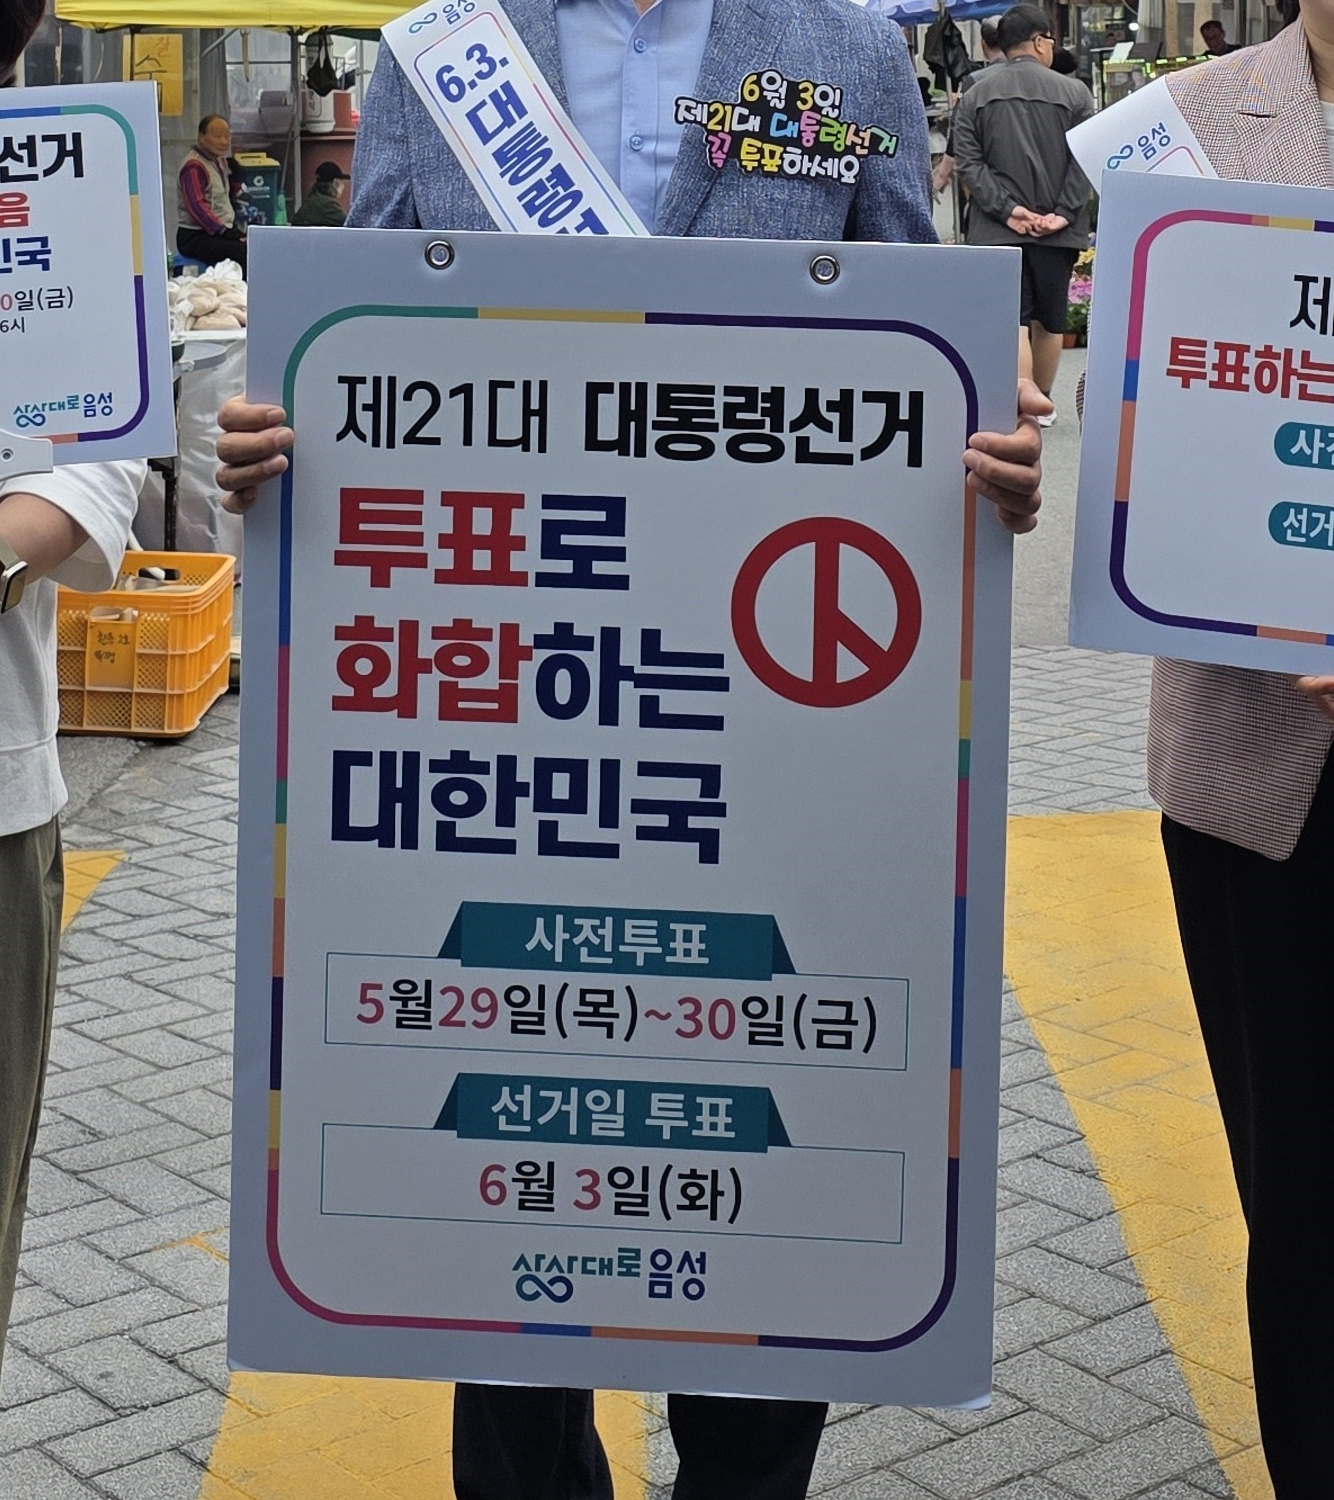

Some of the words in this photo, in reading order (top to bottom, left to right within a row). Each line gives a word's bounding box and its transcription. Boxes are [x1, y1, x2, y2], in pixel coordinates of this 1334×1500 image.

[434, 42, 510, 104] 6.3.
[741, 70, 788, 107] 6월
[796, 81, 841, 117] 3일
[676, 97, 761, 134] 제21대
[769, 108, 899, 156] 대통령선거
[1137, 122, 1171, 161] 음성
[706, 131, 732, 169] 꼭
[739, 142, 860, 185] 투표하세요
[0, 315, 27, 336] 6시
[335, 374, 549, 454] 제21대
[584, 380, 924, 468] 대통령선거
[333, 486, 631, 592] 투표로
[331, 615, 731, 731] 화합하는
[331, 748, 727, 865] 대한민국
[525, 914, 709, 966] 사전투표
[356, 978, 879, 1054] 5월29일(목)~30일(금)
[491, 1086, 627, 1135] 선거일
[645, 1094, 736, 1140] 투표
[479, 1159, 556, 1212] 6월
[574, 1164, 743, 1225] 3일(화)
